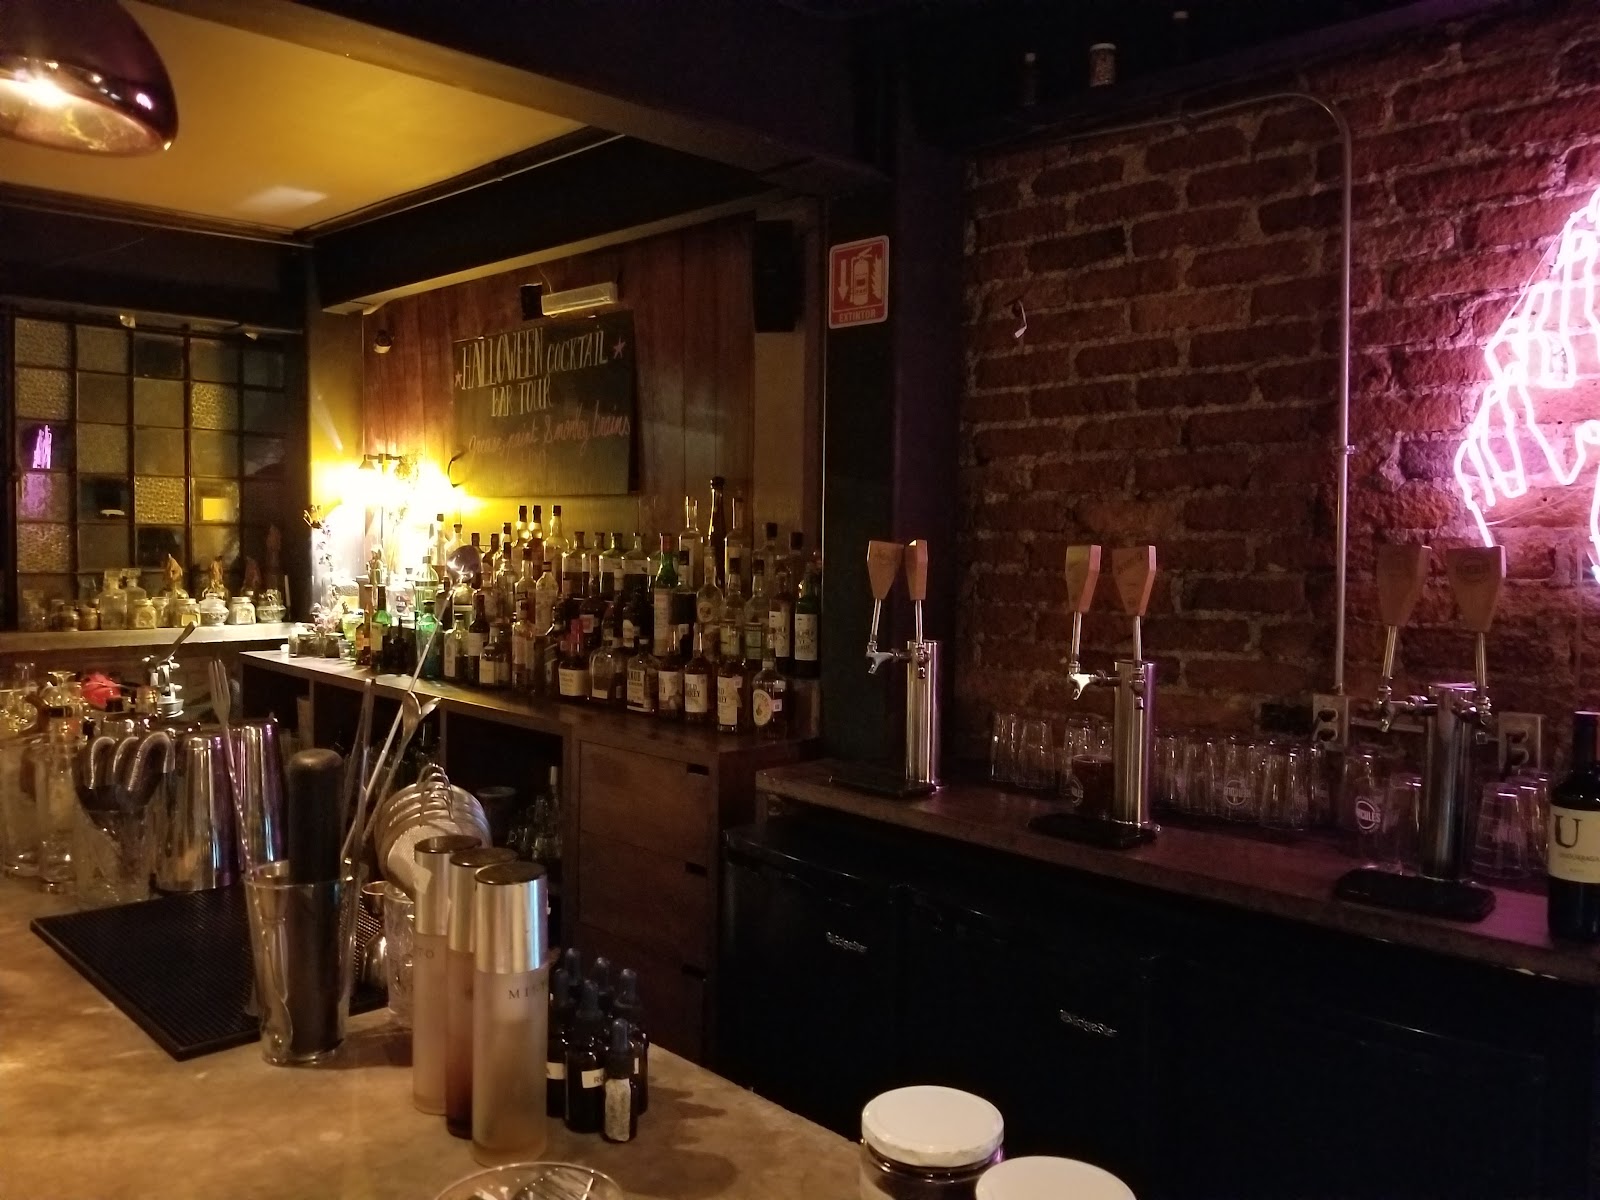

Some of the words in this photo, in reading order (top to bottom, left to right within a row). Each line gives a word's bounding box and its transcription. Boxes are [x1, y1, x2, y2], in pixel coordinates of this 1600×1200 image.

[838, 308, 876, 323] EXTINTOR
[461, 326, 544, 390] HALLOWEEN
[490, 384, 514, 417] BAR
[518, 373, 554, 415] TOUR
[1553, 813, 1583, 849] U
